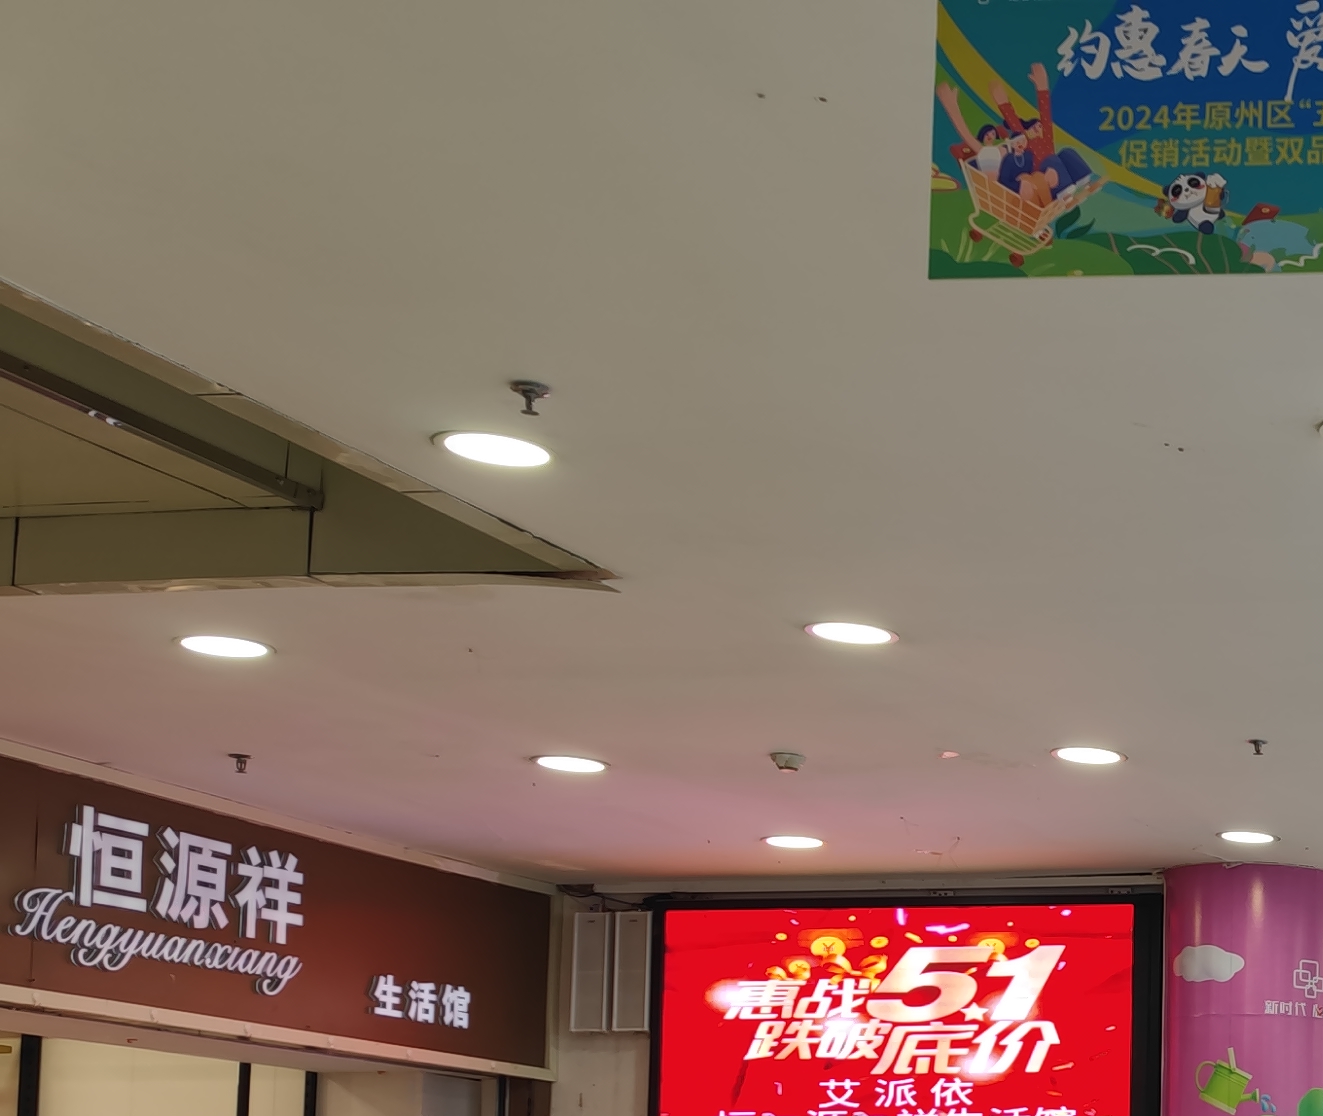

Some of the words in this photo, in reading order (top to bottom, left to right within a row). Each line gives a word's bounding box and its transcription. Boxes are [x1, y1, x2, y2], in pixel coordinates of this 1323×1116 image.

[1056, 6, 1270, 80] 约惠春天
[69, 803, 305, 945] 恒源祥
[8, 885, 303, 996] Hengyuanxiang
[371, 974, 472, 1029] 生活馆
[1265, 1000, 1307, 1017] 新时代
[744, 1019, 1062, 1075] 跌破底价
[819, 1078, 974, 1108] 艾派依
